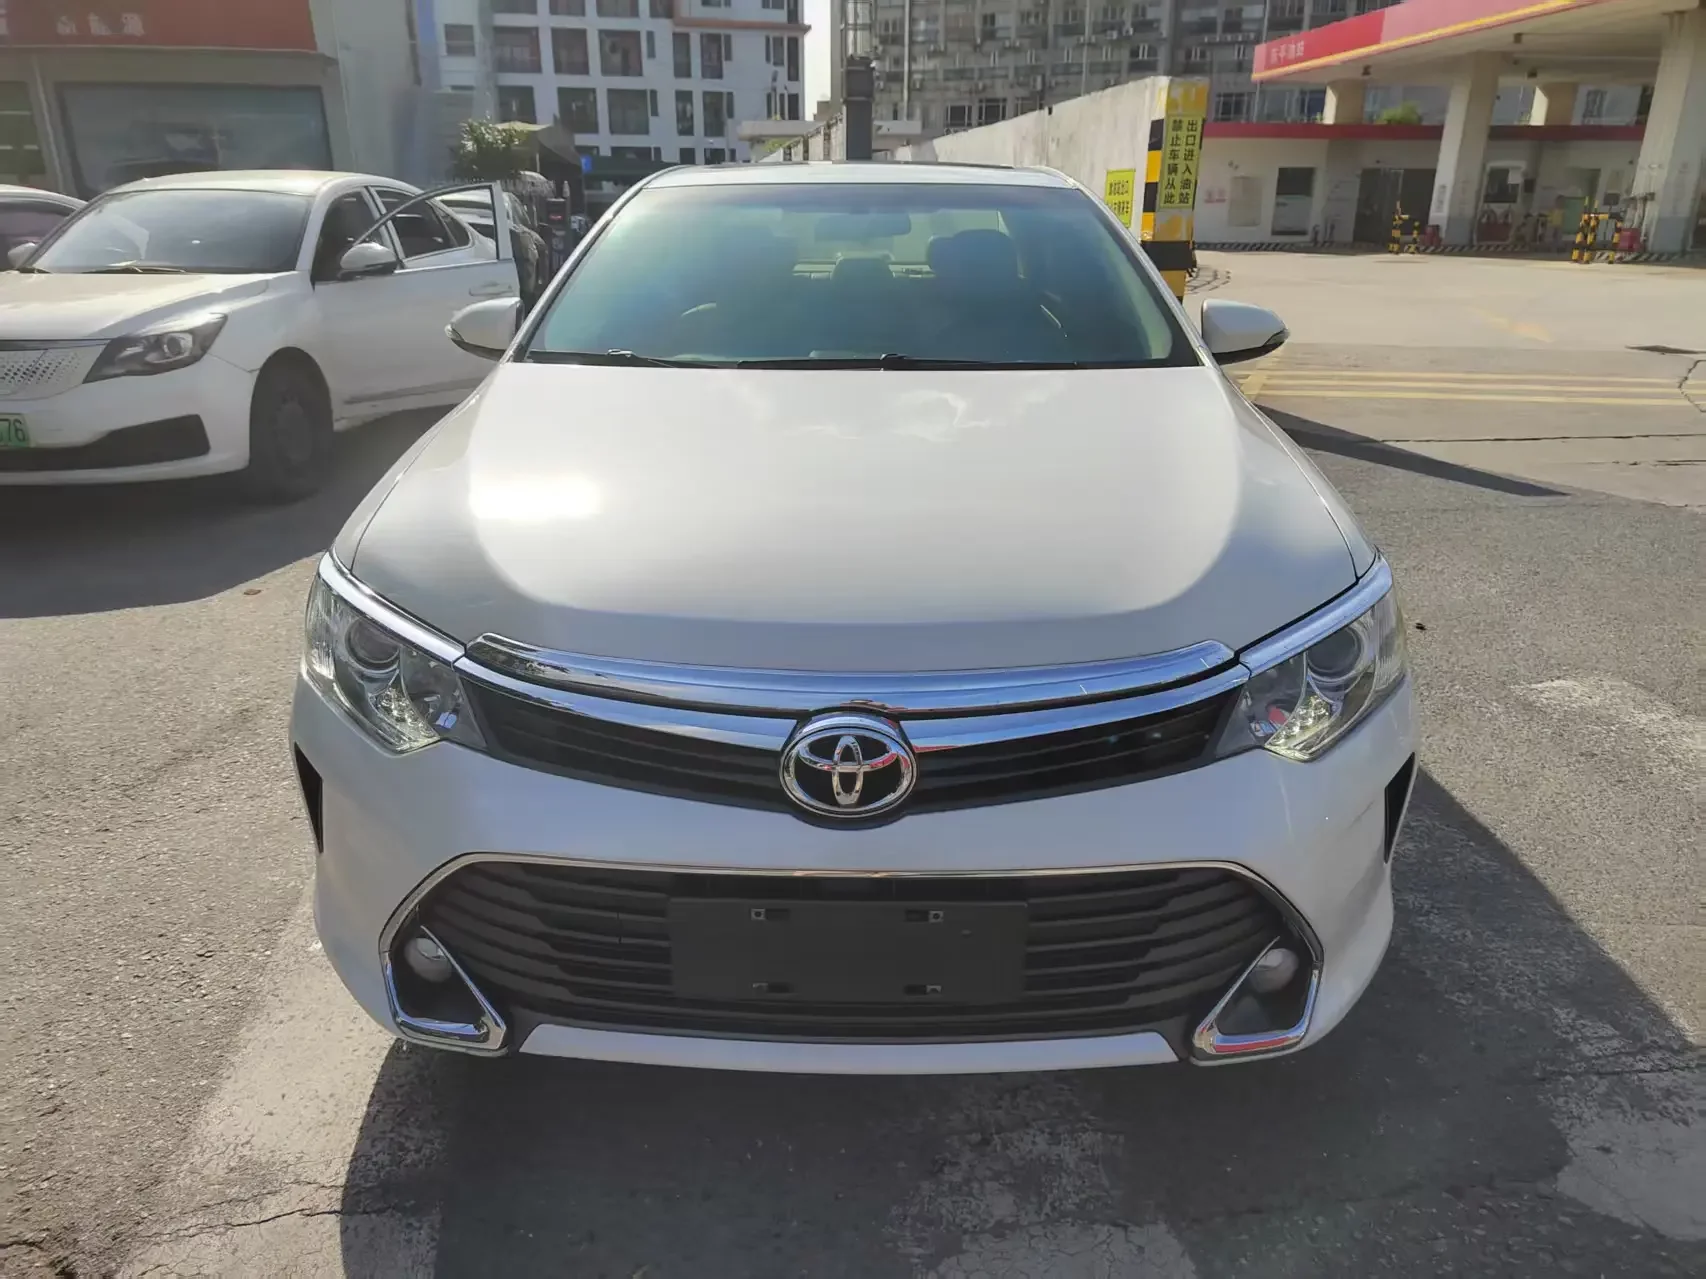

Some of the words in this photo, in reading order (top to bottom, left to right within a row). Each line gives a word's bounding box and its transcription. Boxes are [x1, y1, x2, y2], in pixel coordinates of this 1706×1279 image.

[1163, 119, 1183, 204] 禁止车辆从此
[1177, 119, 1198, 204] 出口进入油站
